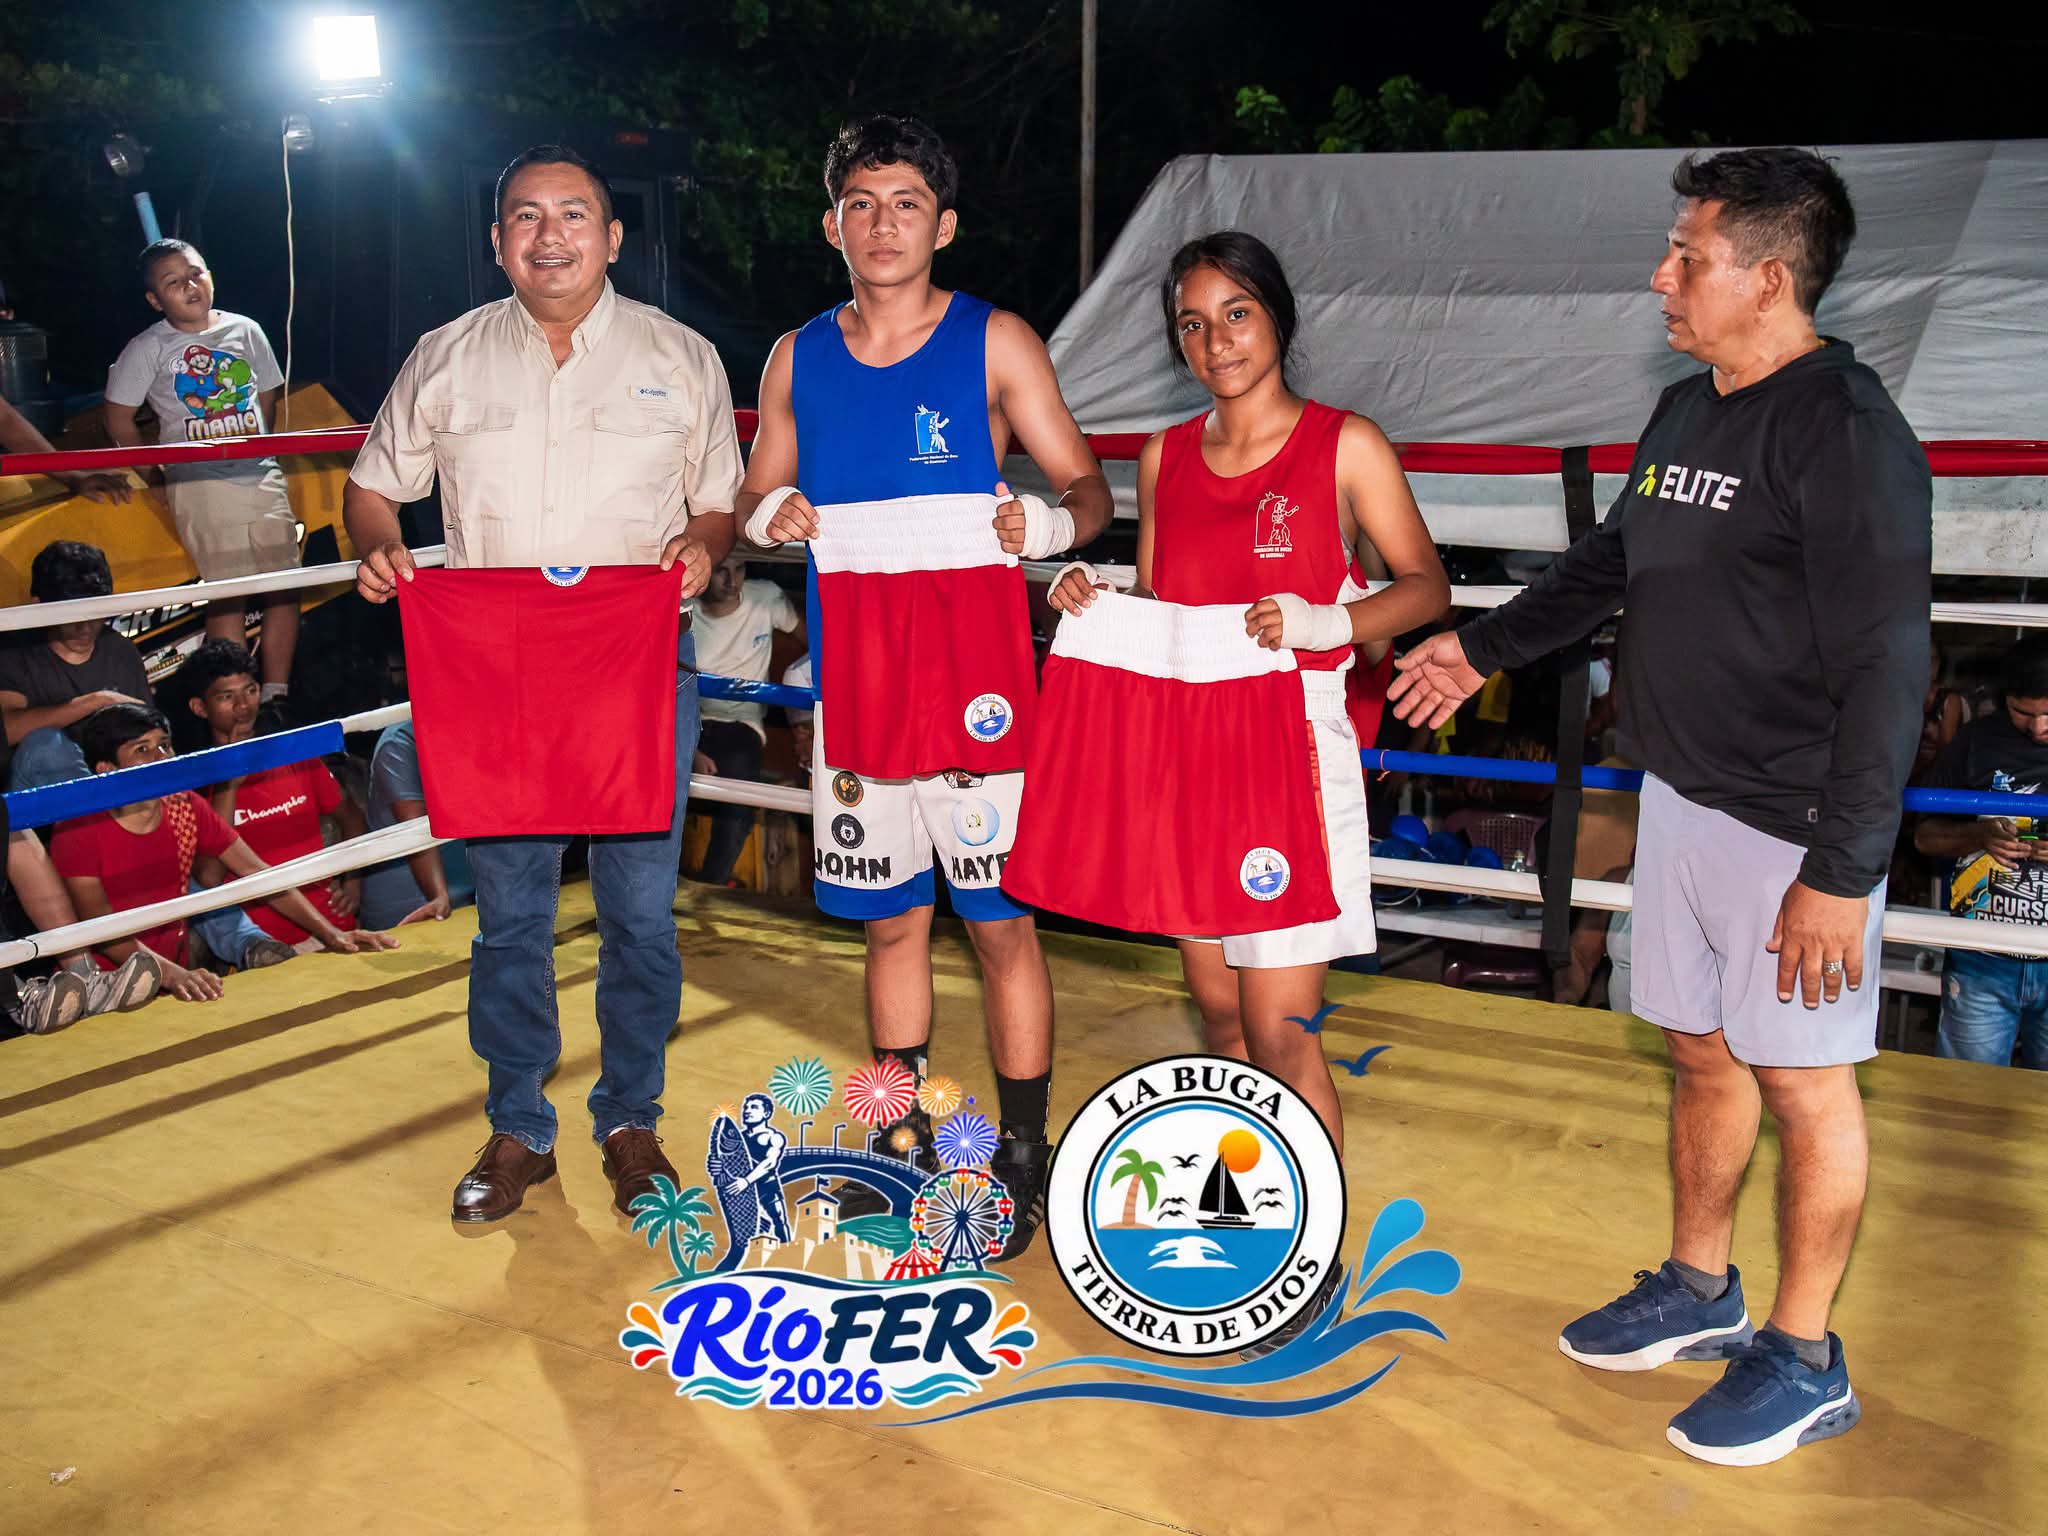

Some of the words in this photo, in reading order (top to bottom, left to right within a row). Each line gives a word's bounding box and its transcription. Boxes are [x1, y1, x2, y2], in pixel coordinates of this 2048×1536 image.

[186, 410, 258, 440] MARIO
[1658, 464, 1742, 511] ELITE
[234, 795, 307, 826] Champio
[815, 848, 892, 884] JOHN
